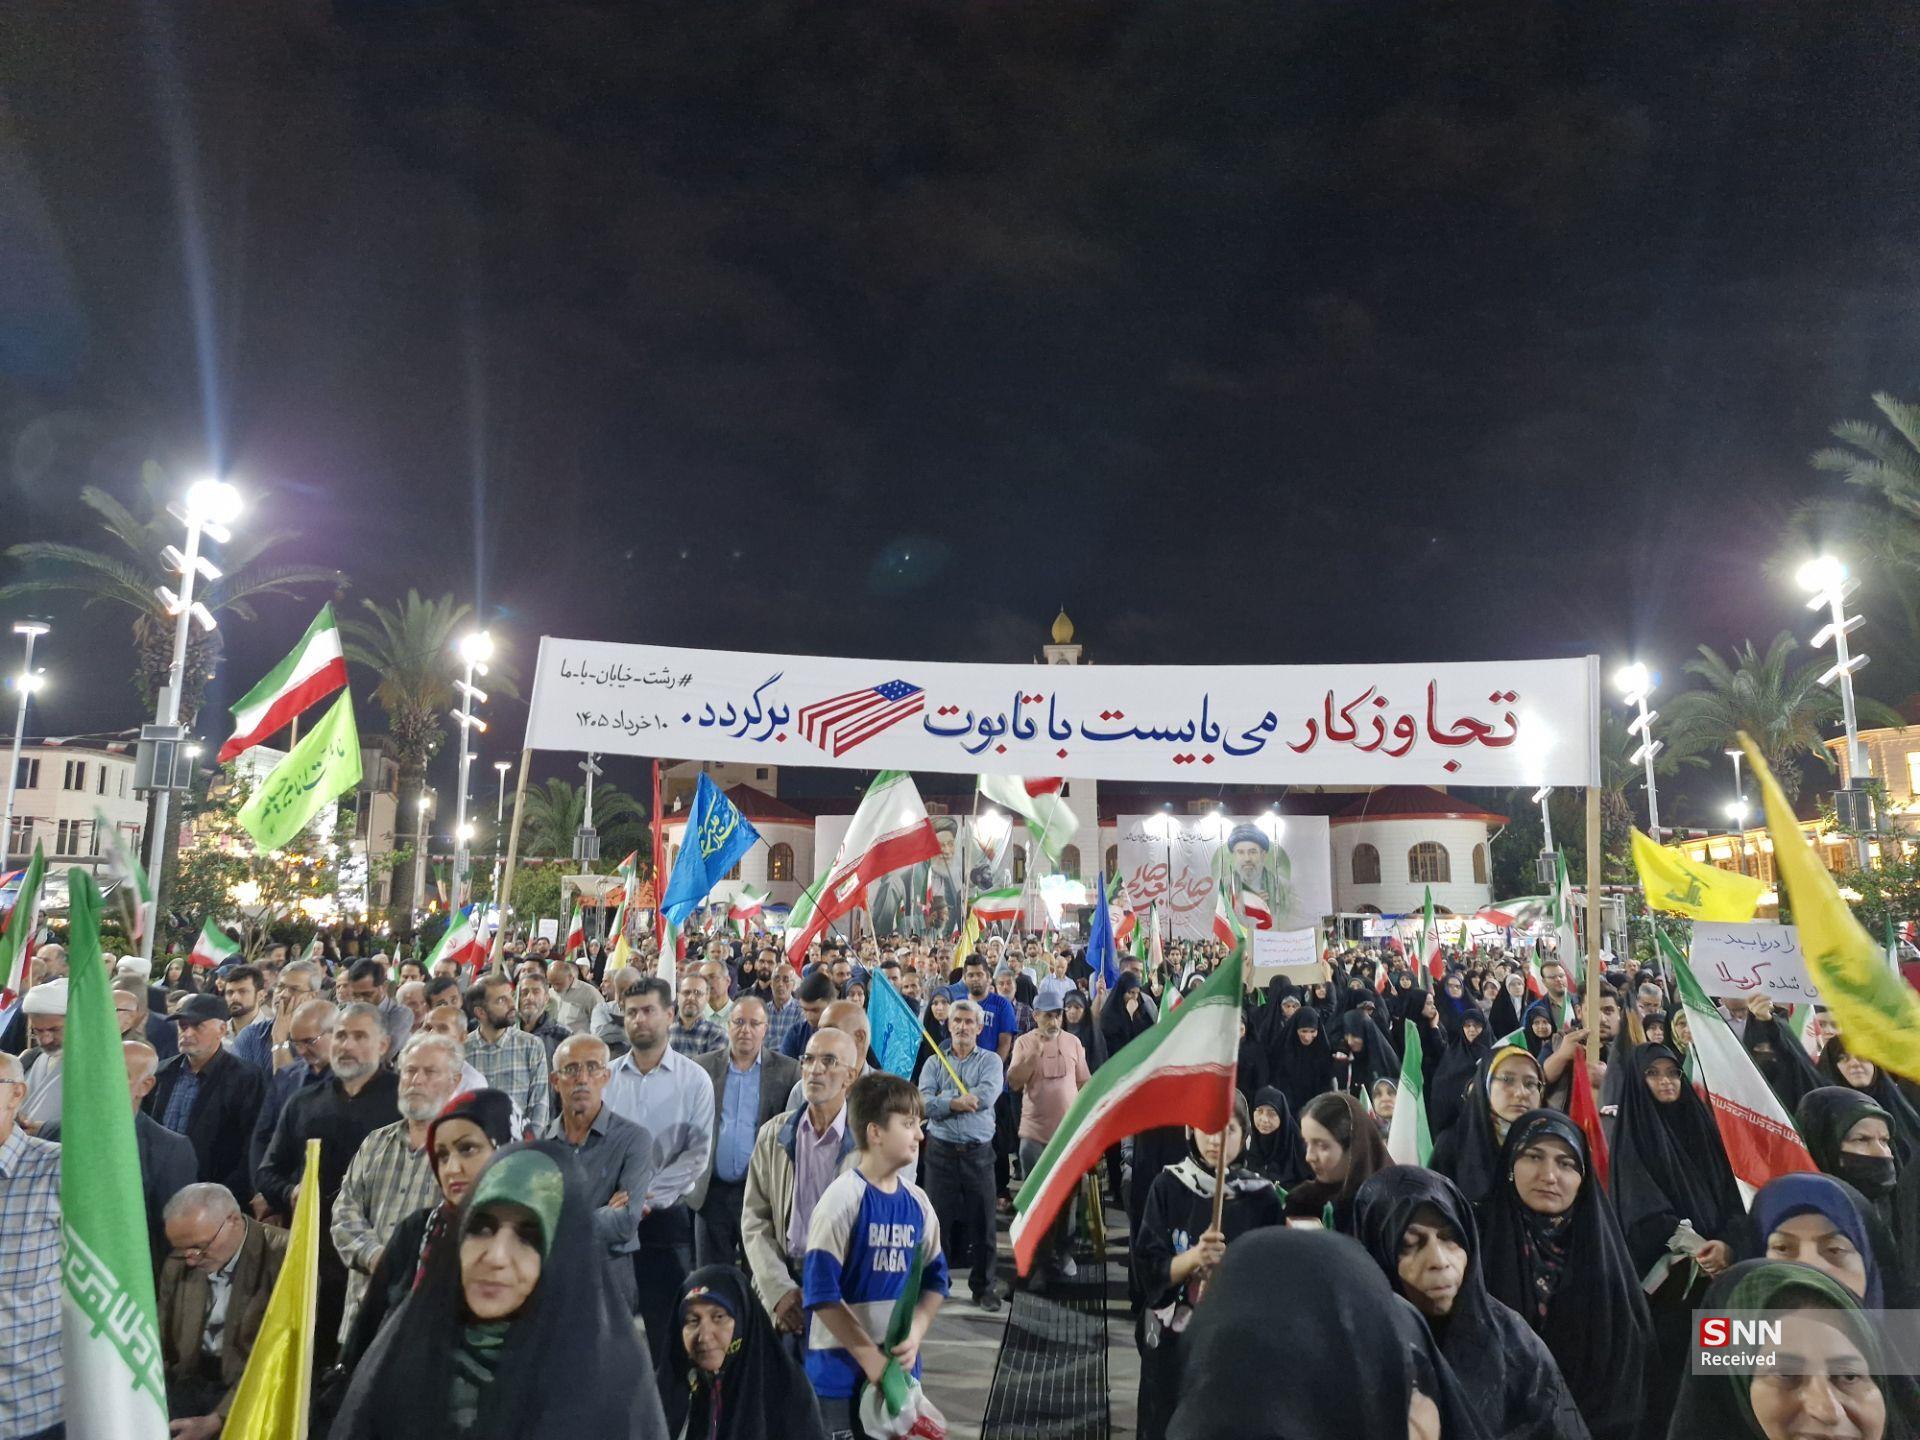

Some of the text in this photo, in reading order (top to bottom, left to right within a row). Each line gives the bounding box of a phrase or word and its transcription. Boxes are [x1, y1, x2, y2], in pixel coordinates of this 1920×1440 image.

[612, 709, 652, 737] خرداد
[922, 689, 1045, 756] تابوت
[1047, 690, 1073, 760] با
[1780, 929, 1795, 954] را
[1716, 960, 1801, 990] شده کربلا
[868, 1222, 915, 1248] BALENC
